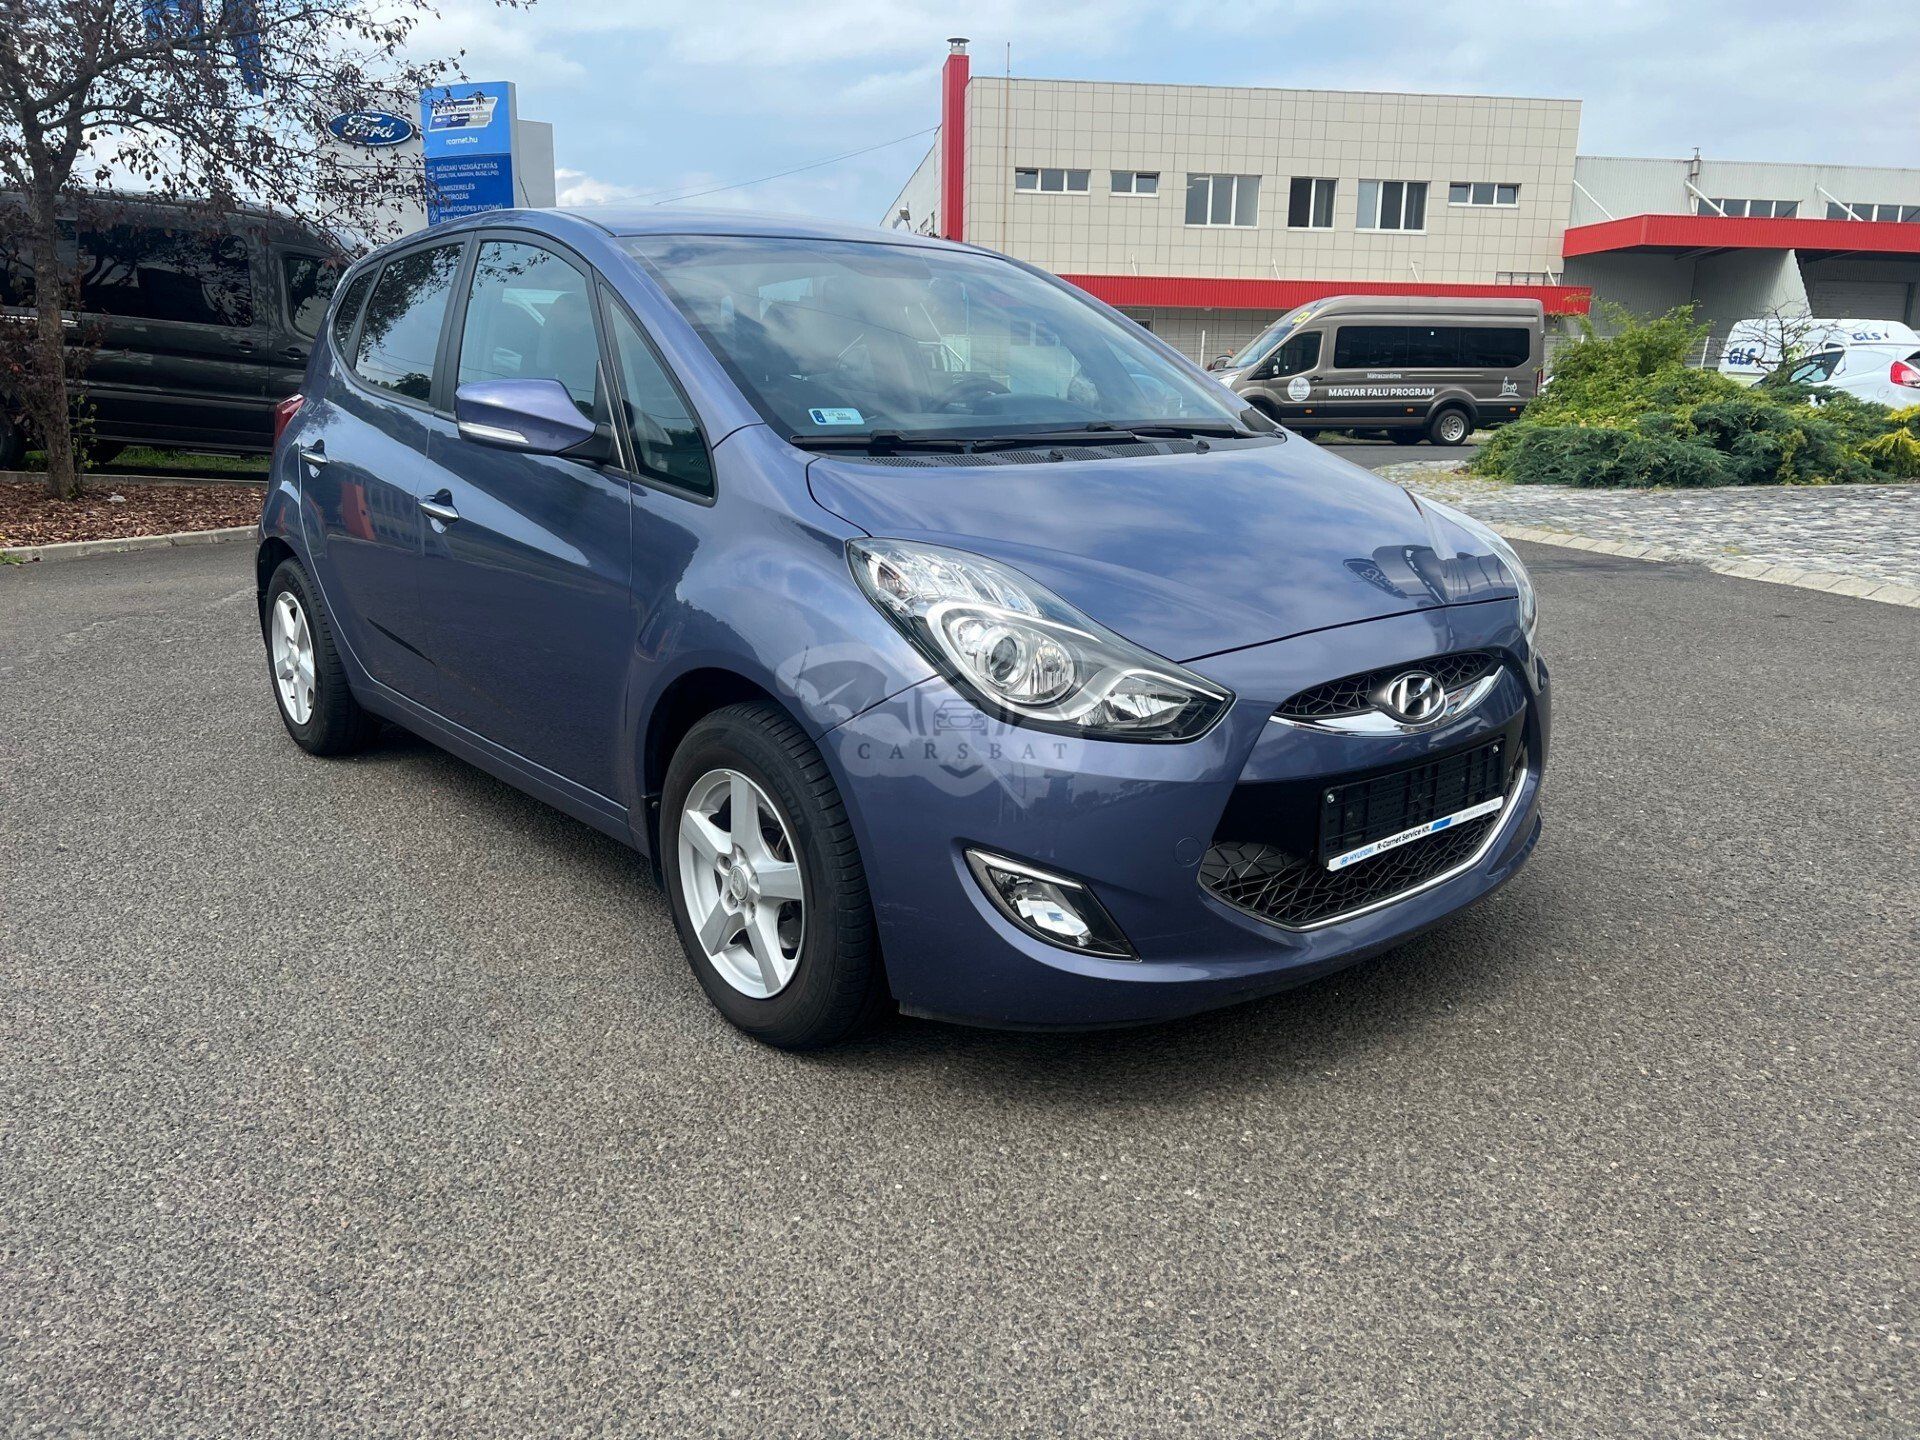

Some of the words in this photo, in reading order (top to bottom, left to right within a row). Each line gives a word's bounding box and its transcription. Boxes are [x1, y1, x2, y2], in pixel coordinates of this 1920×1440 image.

[343, 115, 396, 137] Ford
[1852, 332, 1882, 341] GLS
[1728, 347, 1757, 366] GLS
[1328, 387, 1366, 397] MAGYAR
[1367, 388, 1389, 397] FALU
[1390, 387, 1435, 396] PROGRAM
[1349, 847, 1374, 861] HYUNDAI
[1402, 829, 1421, 842] Service
